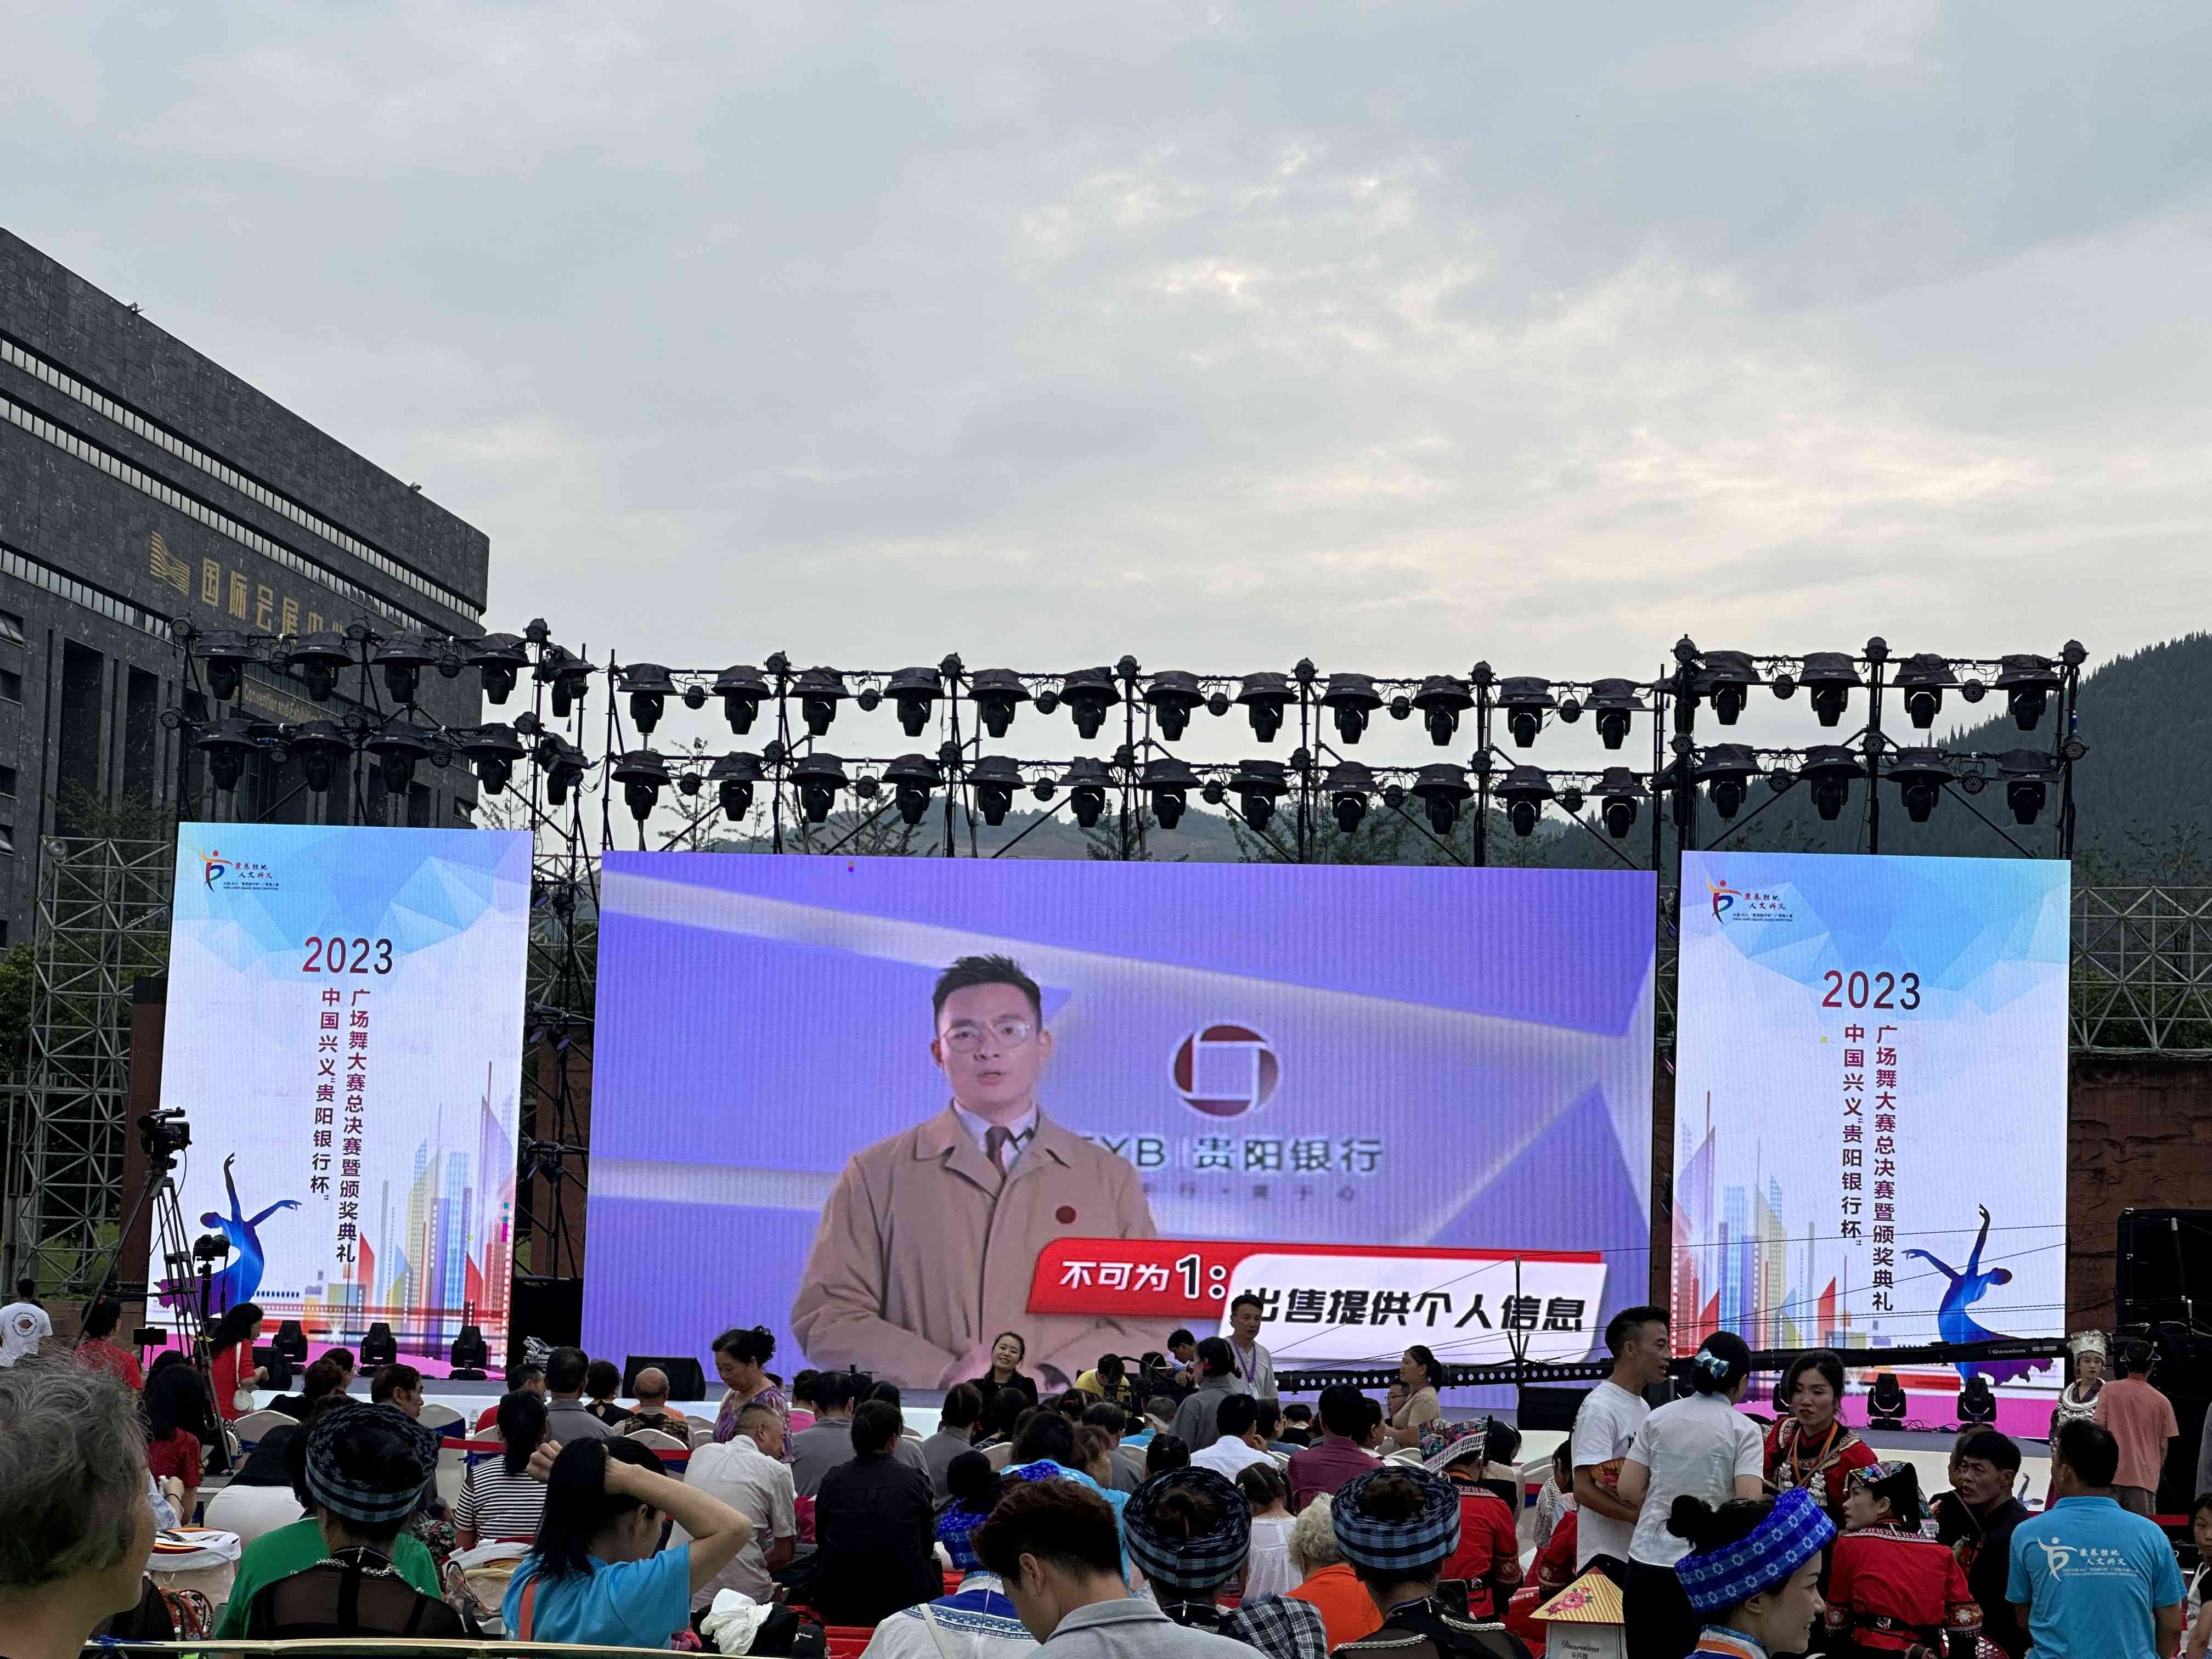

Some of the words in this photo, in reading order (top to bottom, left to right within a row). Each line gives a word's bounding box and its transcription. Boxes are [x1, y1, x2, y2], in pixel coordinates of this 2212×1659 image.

[303, 936, 392, 974] 2023
[1822, 970, 1920, 1010] 2023
[336, 989, 371, 1263] 广场舞大赛总决赛暨颁奖典礼
[1082, 1137, 1165, 1166] YB
[1194, 1137, 1383, 1172] 贵阳银行
[1872, 1025, 1898, 1311] 广场舞大赛总决赛暨颁奖典礼
